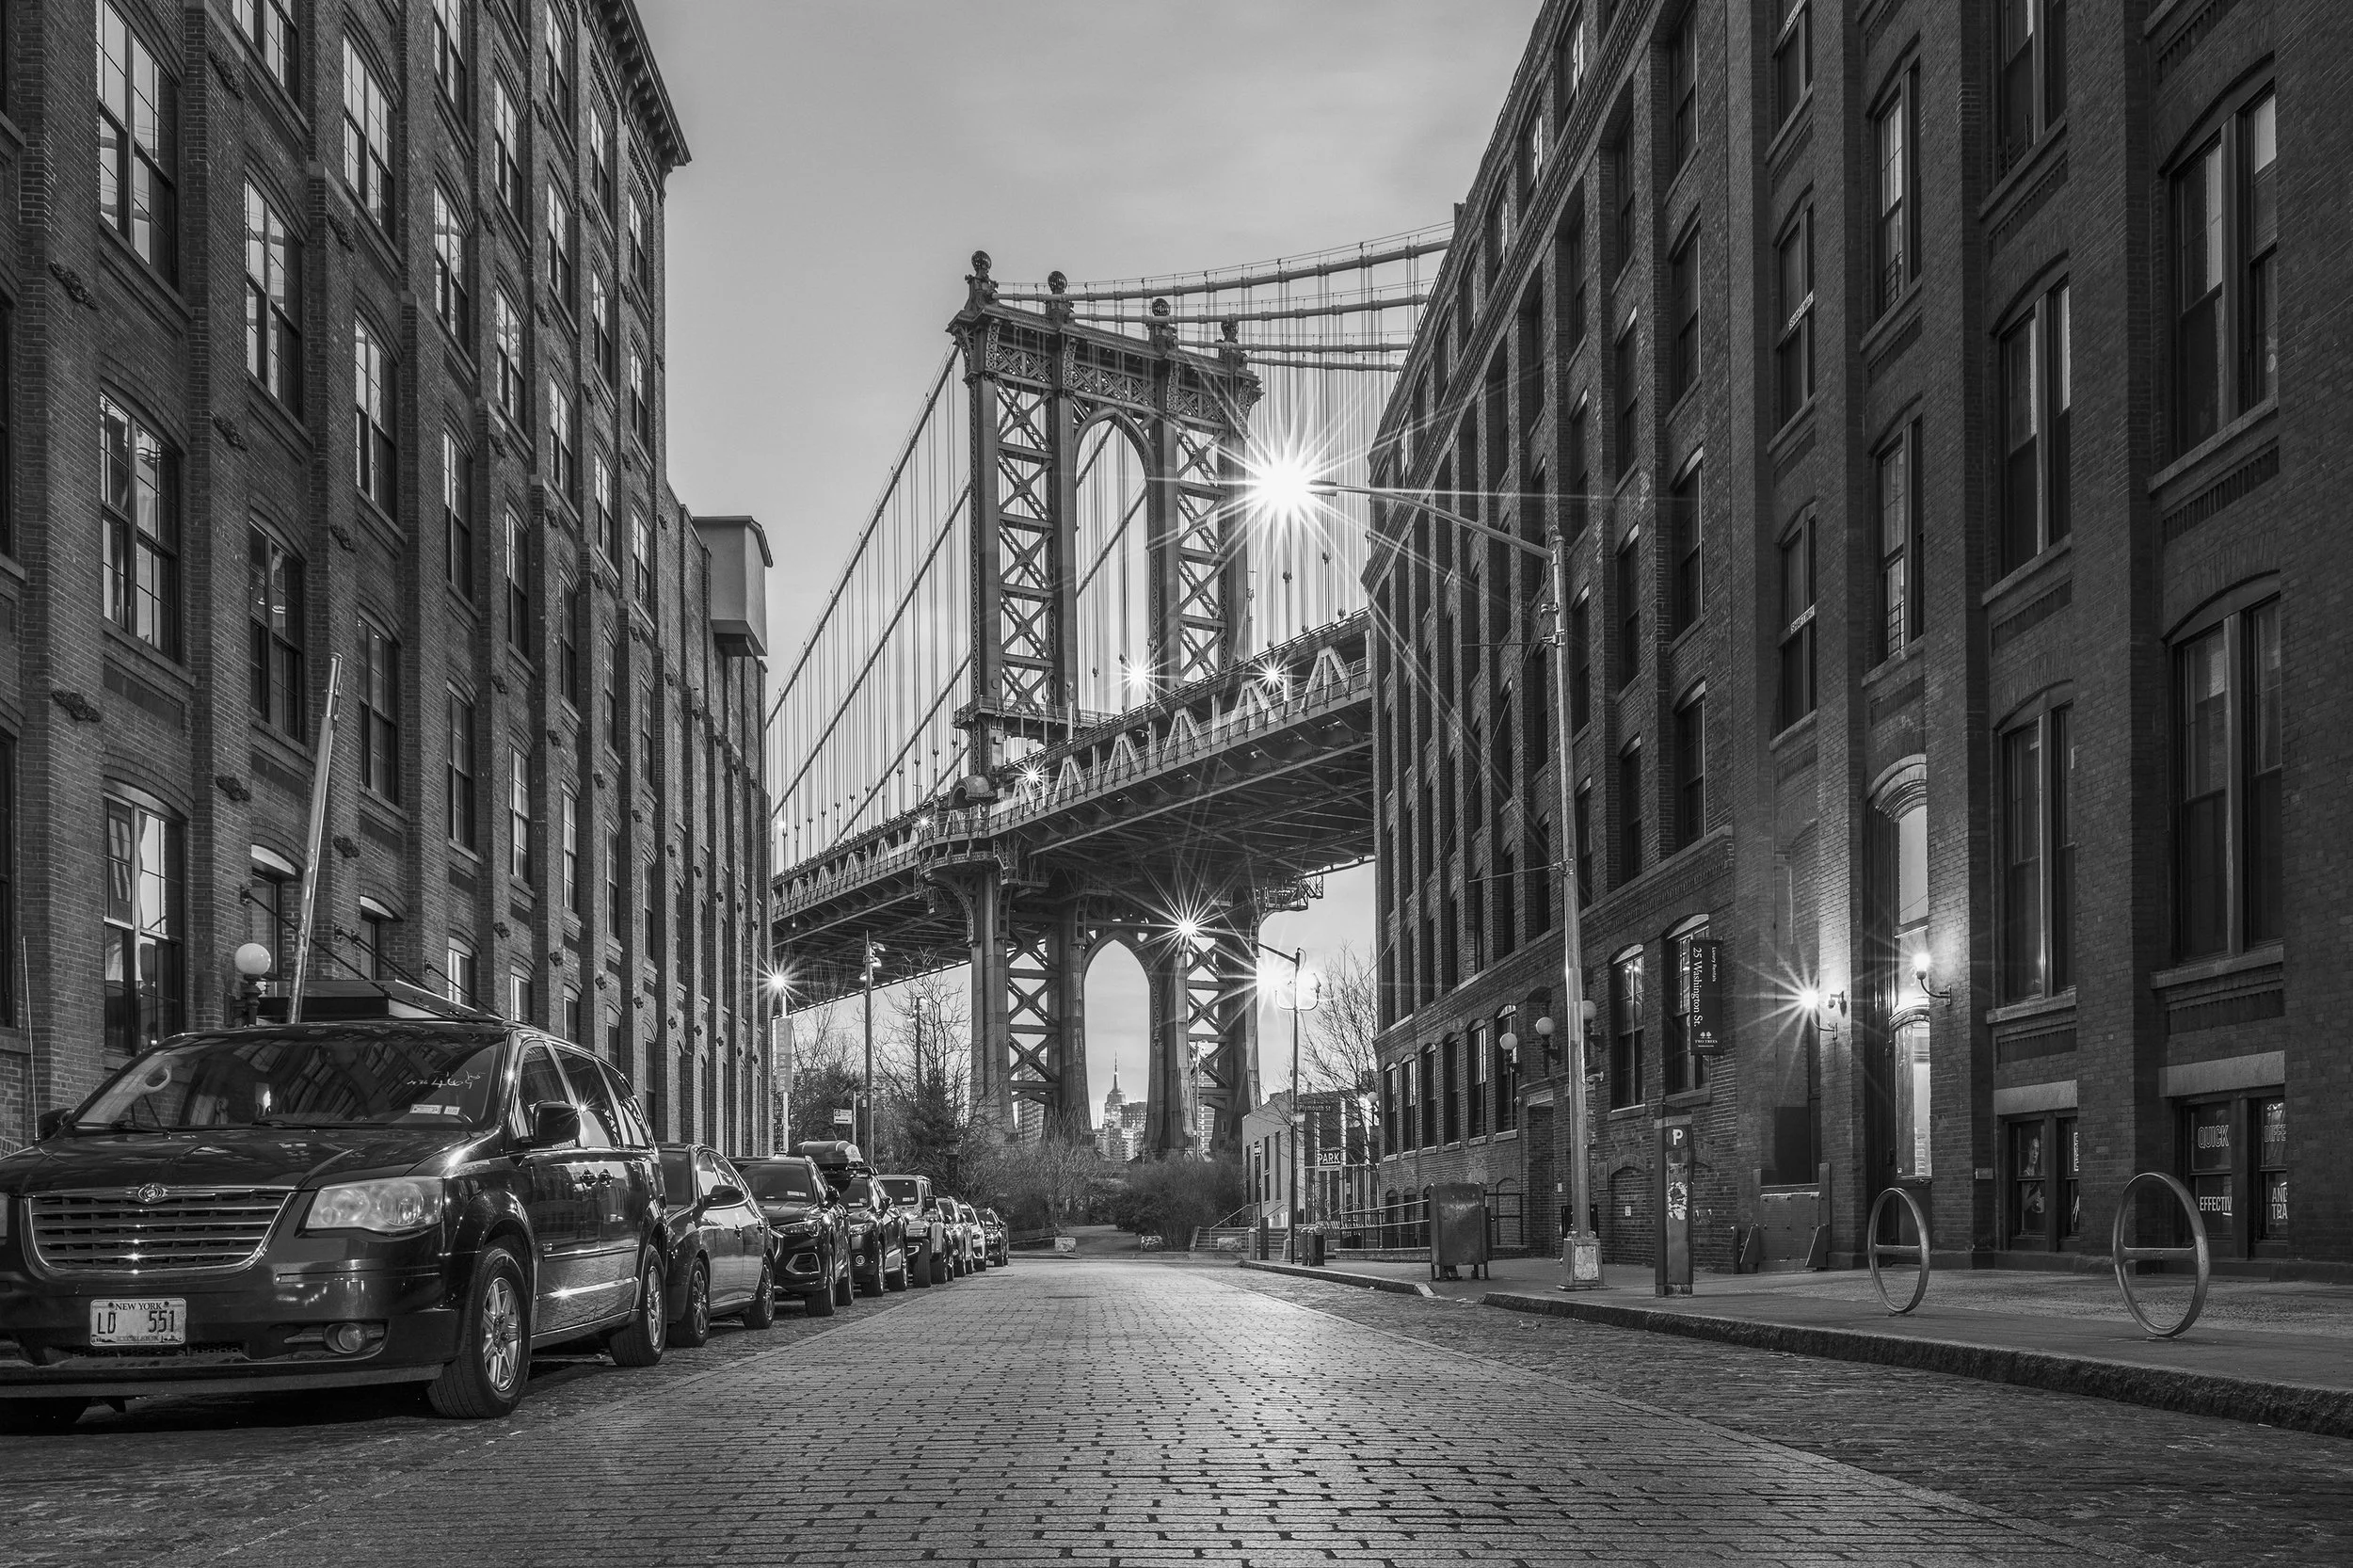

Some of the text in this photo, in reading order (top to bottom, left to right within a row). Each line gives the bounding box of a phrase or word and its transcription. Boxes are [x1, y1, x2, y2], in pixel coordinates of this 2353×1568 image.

[1690, 947, 1704, 1028] 25 Washington St.
[1673, 1128, 1684, 1145] P
[2198, 1125, 2230, 1149] QUICK
[1317, 1152, 1340, 1163] PARK
[2272, 1204, 2288, 1220] TRA
[115, 1302, 163, 1311] NEW YORK
[97, 1310, 175, 1335] LD 551
